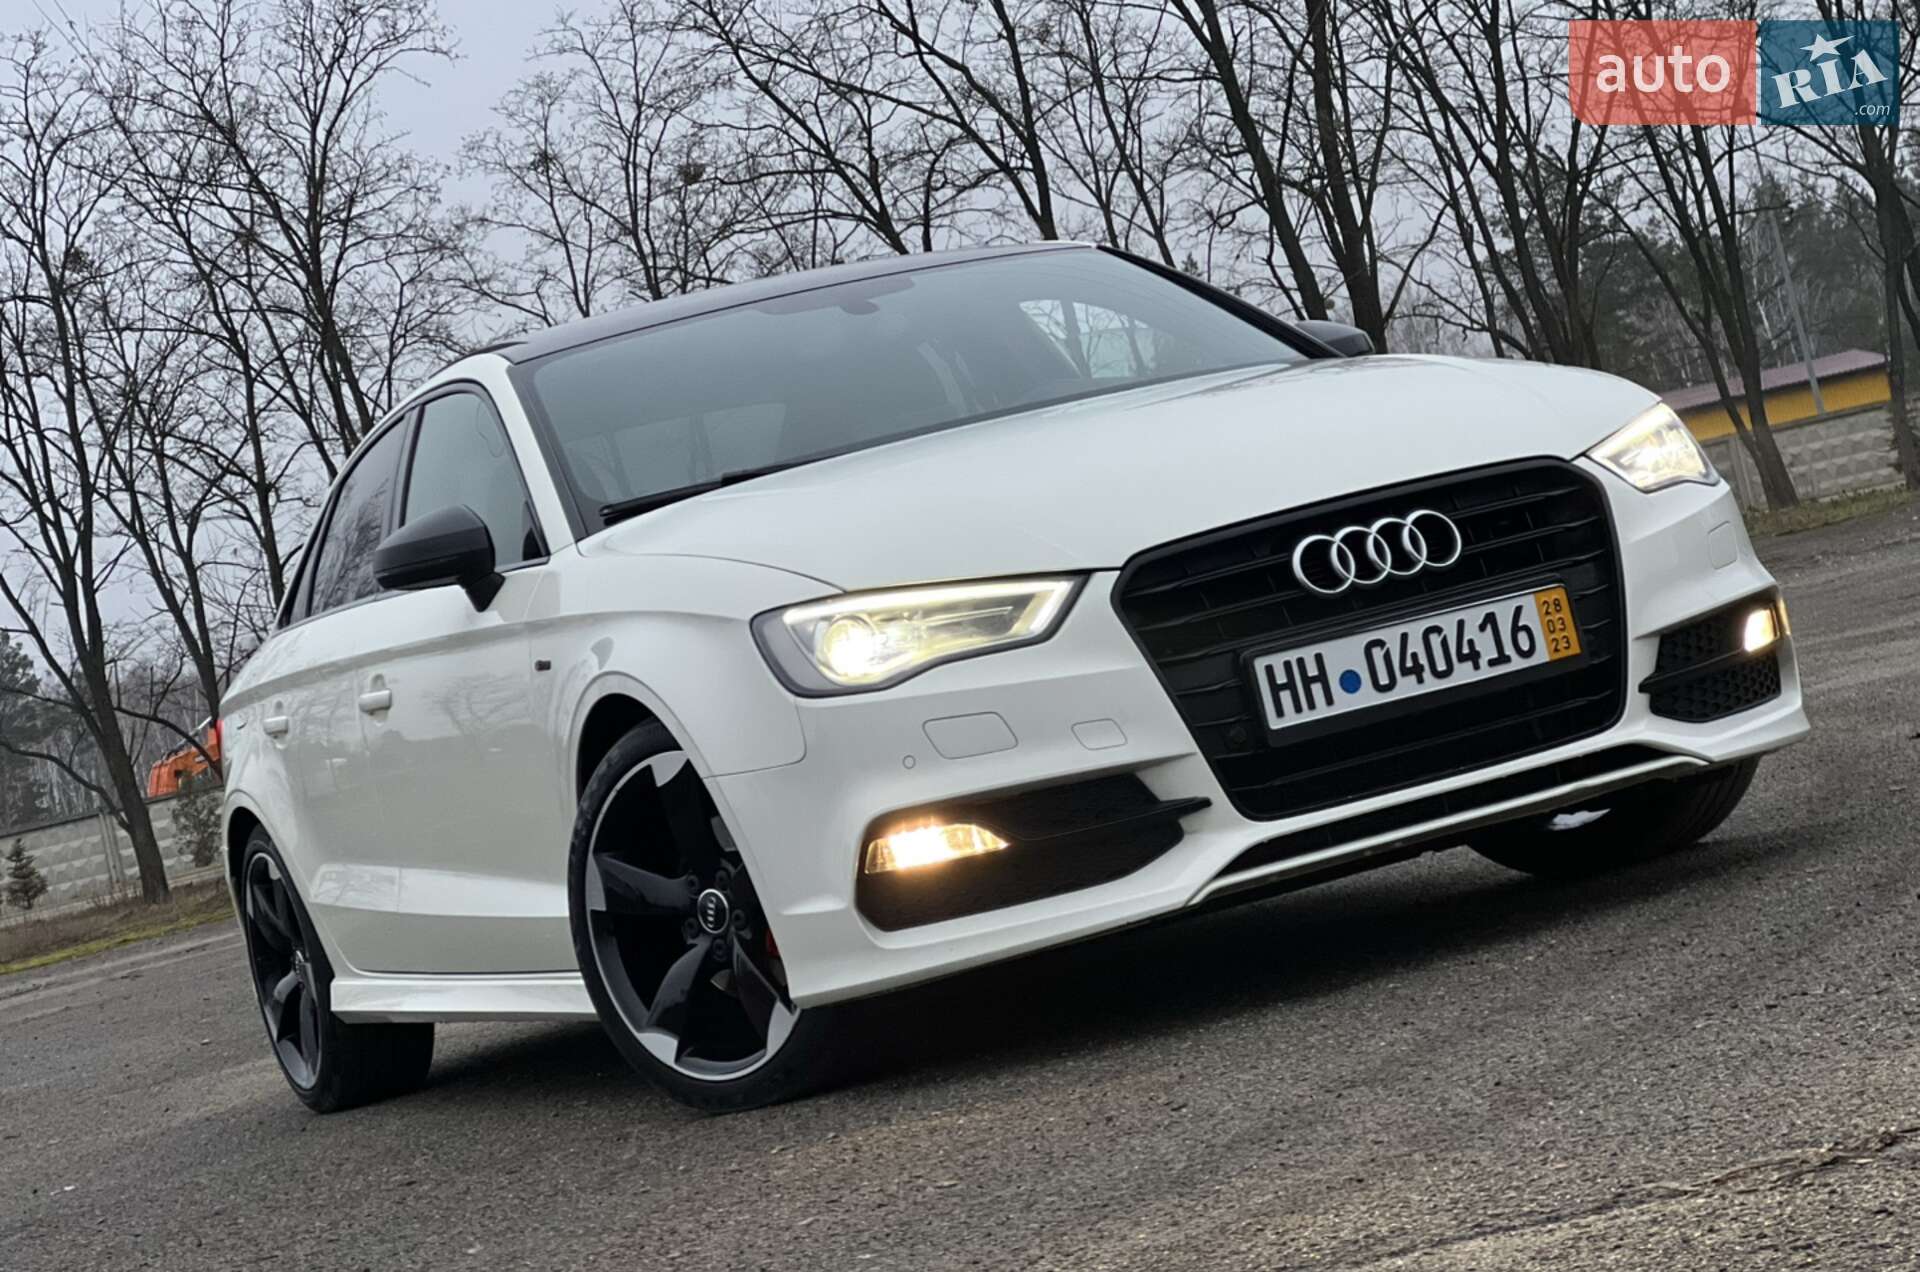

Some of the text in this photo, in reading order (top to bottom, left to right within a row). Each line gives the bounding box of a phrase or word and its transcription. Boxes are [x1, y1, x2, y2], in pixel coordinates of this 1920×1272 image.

[1542, 598, 1562, 615] 28
[1546, 618, 1566, 634] 03
[1551, 636, 1571, 652] 23
[1265, 605, 1536, 717] HH 040416
